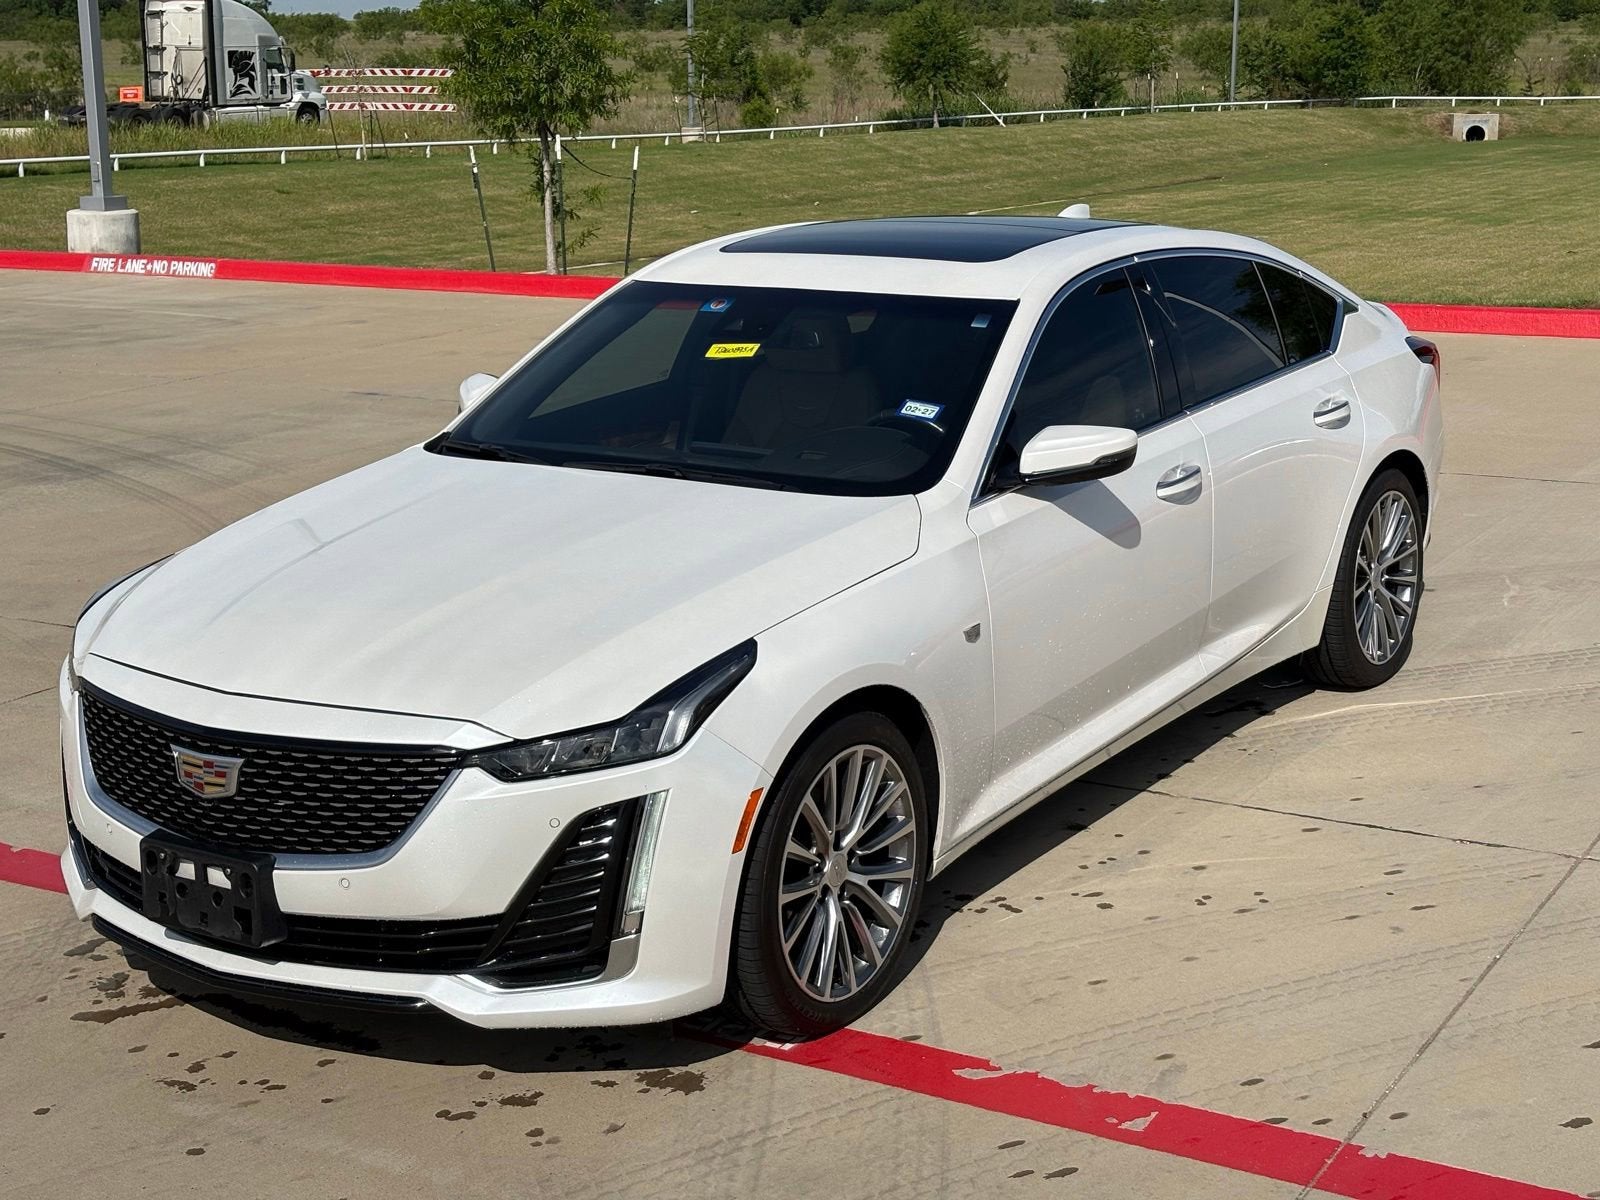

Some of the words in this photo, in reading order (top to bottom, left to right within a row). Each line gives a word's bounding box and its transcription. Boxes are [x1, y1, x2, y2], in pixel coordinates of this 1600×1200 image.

[91, 257, 116, 272] FIRE
[117, 258, 147, 274] LANE
[151, 260, 168, 275] NO
[170, 260, 216, 277] PARKING
